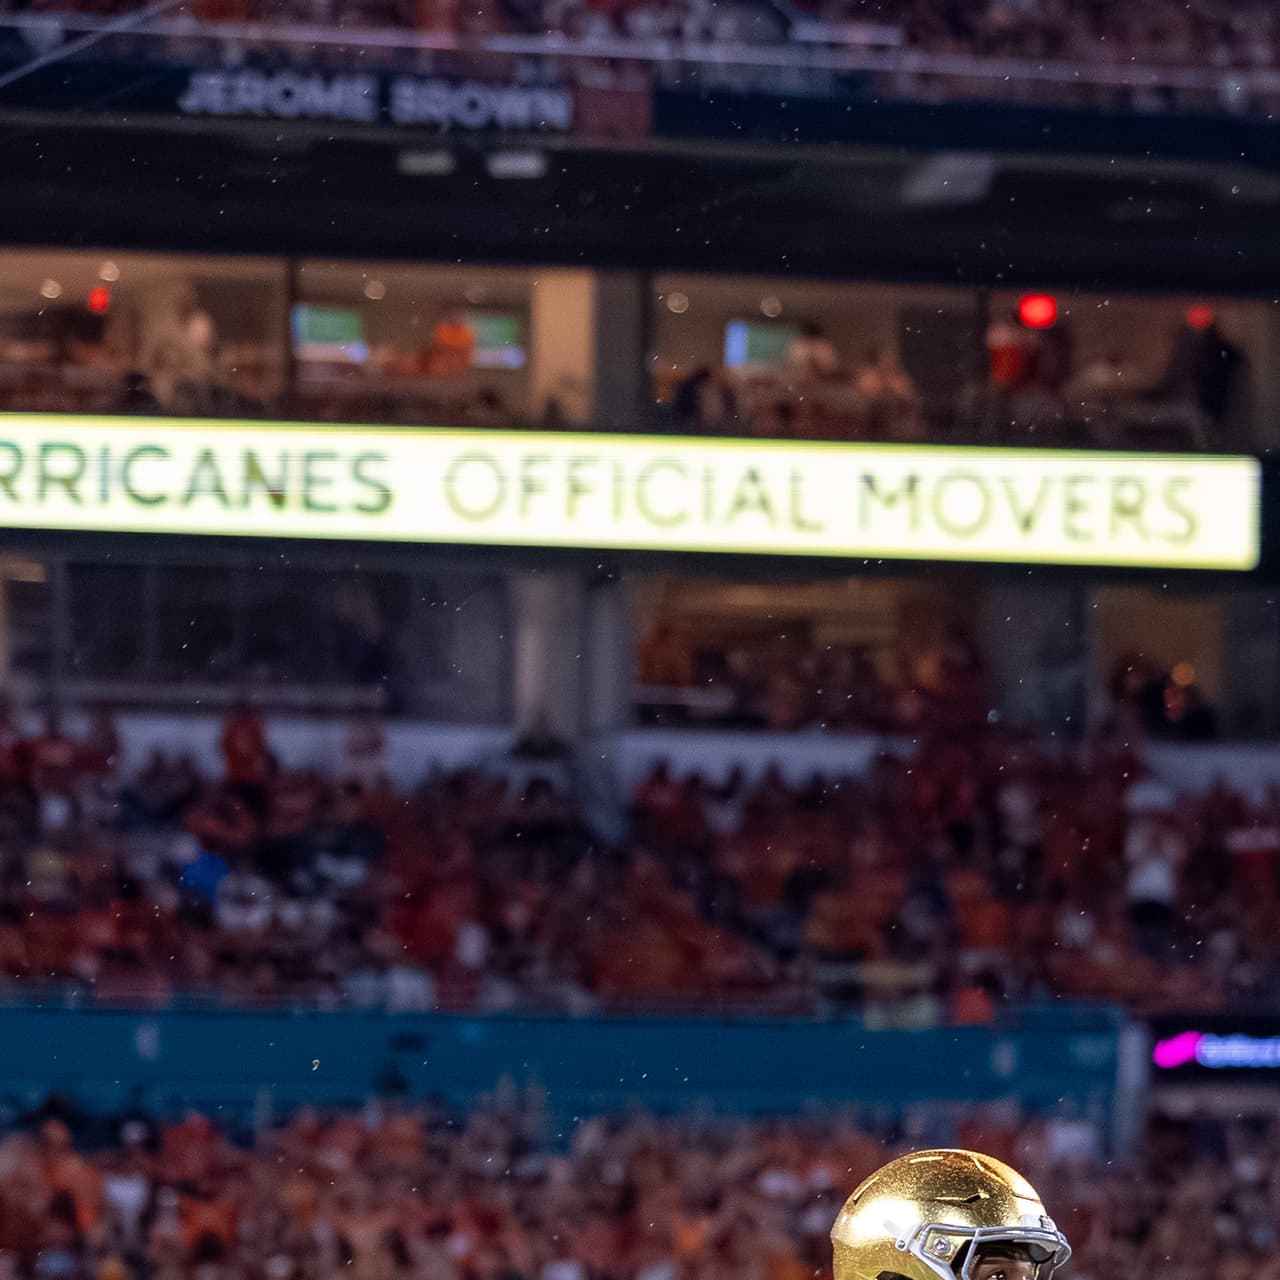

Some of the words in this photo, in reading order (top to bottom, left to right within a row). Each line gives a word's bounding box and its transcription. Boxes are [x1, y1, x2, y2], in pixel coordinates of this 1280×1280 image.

[179, 71, 378, 121] JEROME
[389, 79, 573, 130] BROWN
[0, 441, 394, 515] RRICANES
[444, 451, 823, 533] OFFICIAL
[859, 469, 1198, 544] MOVERS
